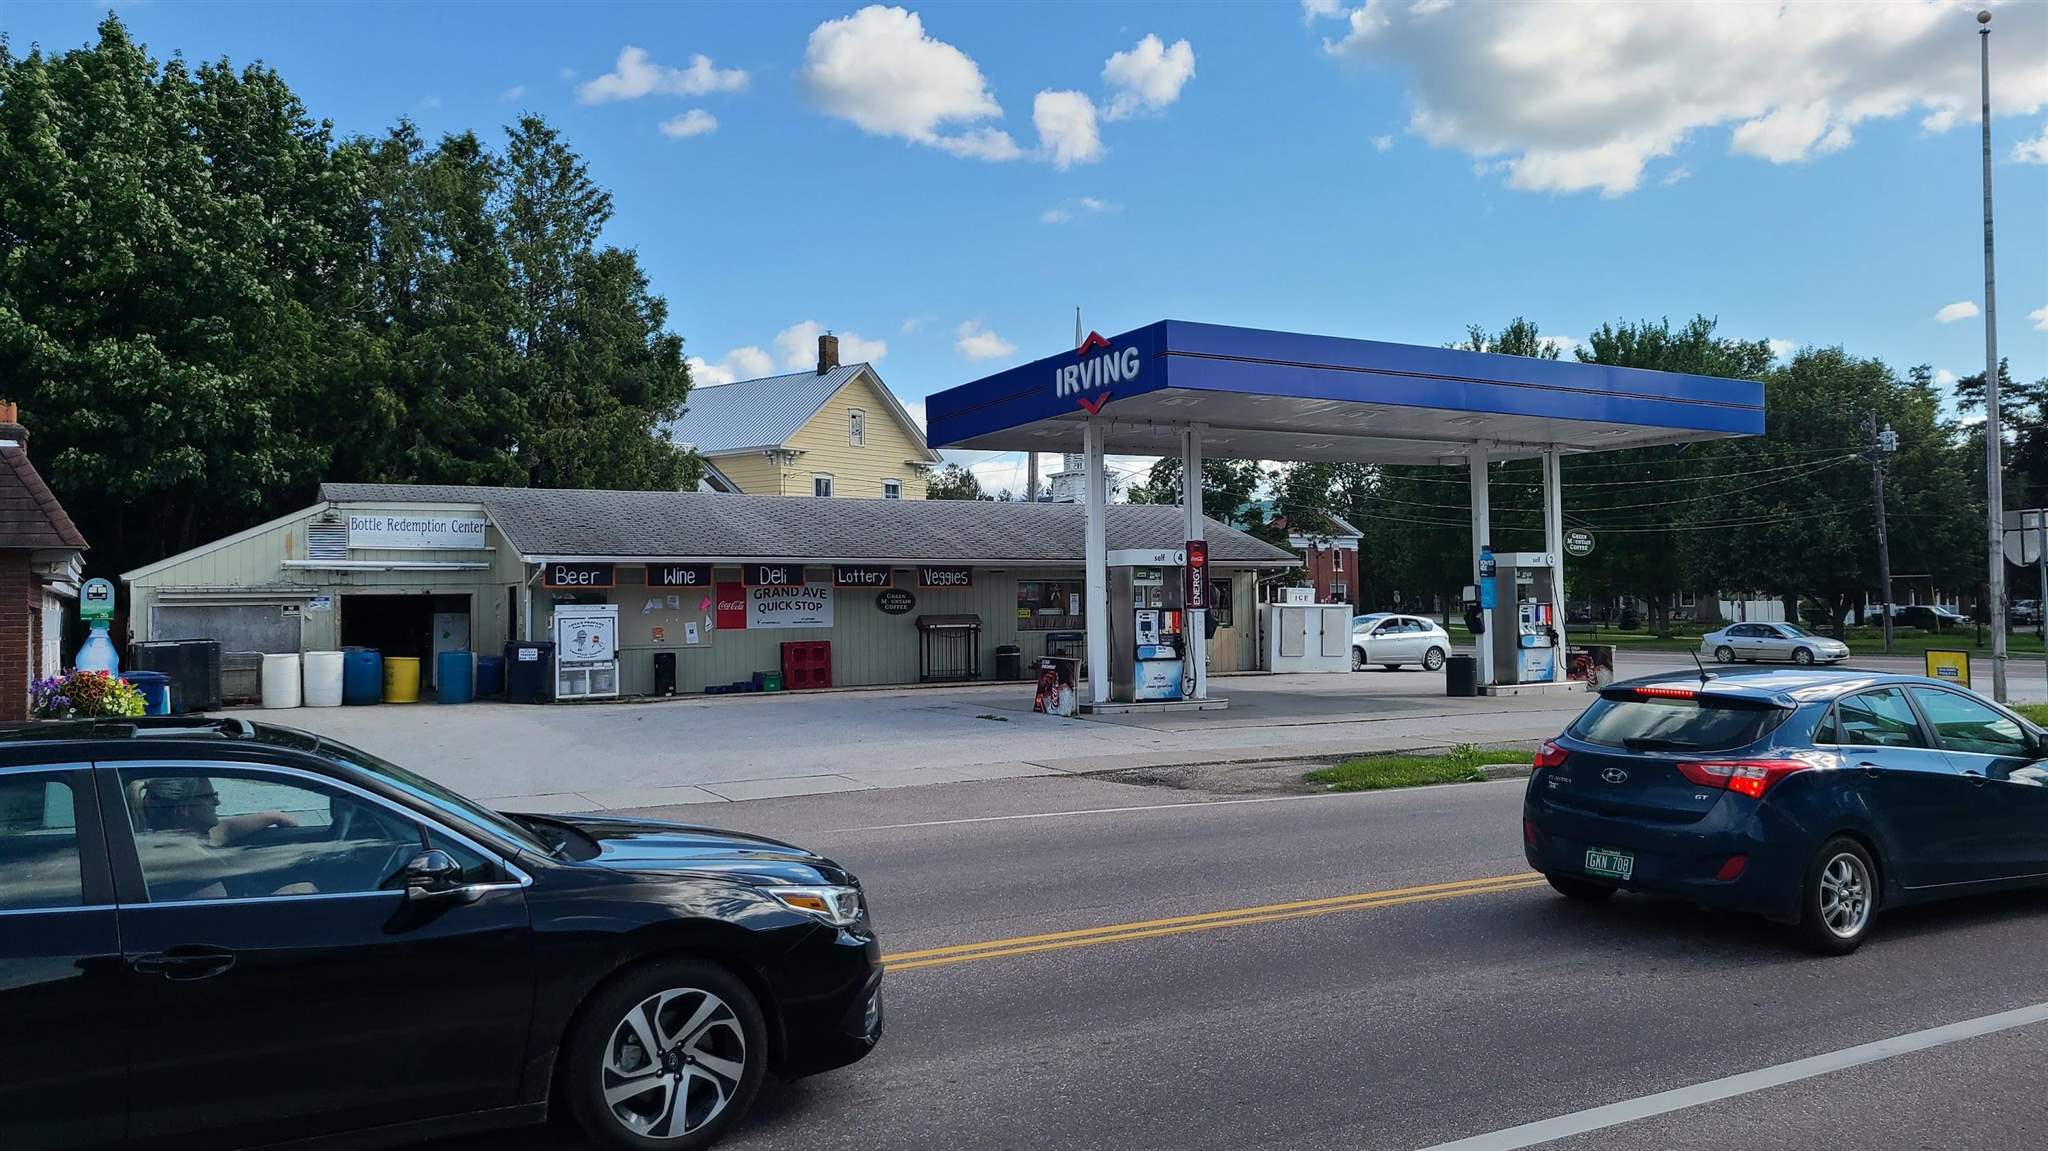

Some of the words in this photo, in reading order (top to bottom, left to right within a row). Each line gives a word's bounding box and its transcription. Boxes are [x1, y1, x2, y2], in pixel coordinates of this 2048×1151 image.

[1056, 346, 1139, 398] IRVING
[351, 517, 382, 531] Bottle
[387, 518, 447, 535] Redemption
[451, 519, 484, 533] Center
[1154, 553, 1166, 562] self
[1177, 553, 1183, 561] 4
[1548, 555, 1554, 563] 2
[555, 565, 600, 585] Beer
[664, 567, 696, 584] Wine
[760, 566, 787, 585] Deli
[838, 569, 887, 585] Lottery
[924, 569, 968, 585] Veggies
[753, 587, 799, 600] GRAND
[802, 587, 827, 600] AVE
[1193, 567, 1201, 606] ENERGY
[758, 601, 793, 614] QUICK
[795, 601, 823, 612] STOP
[1590, 854, 1608, 869] GKN
[1612, 856, 1629, 873] 708
